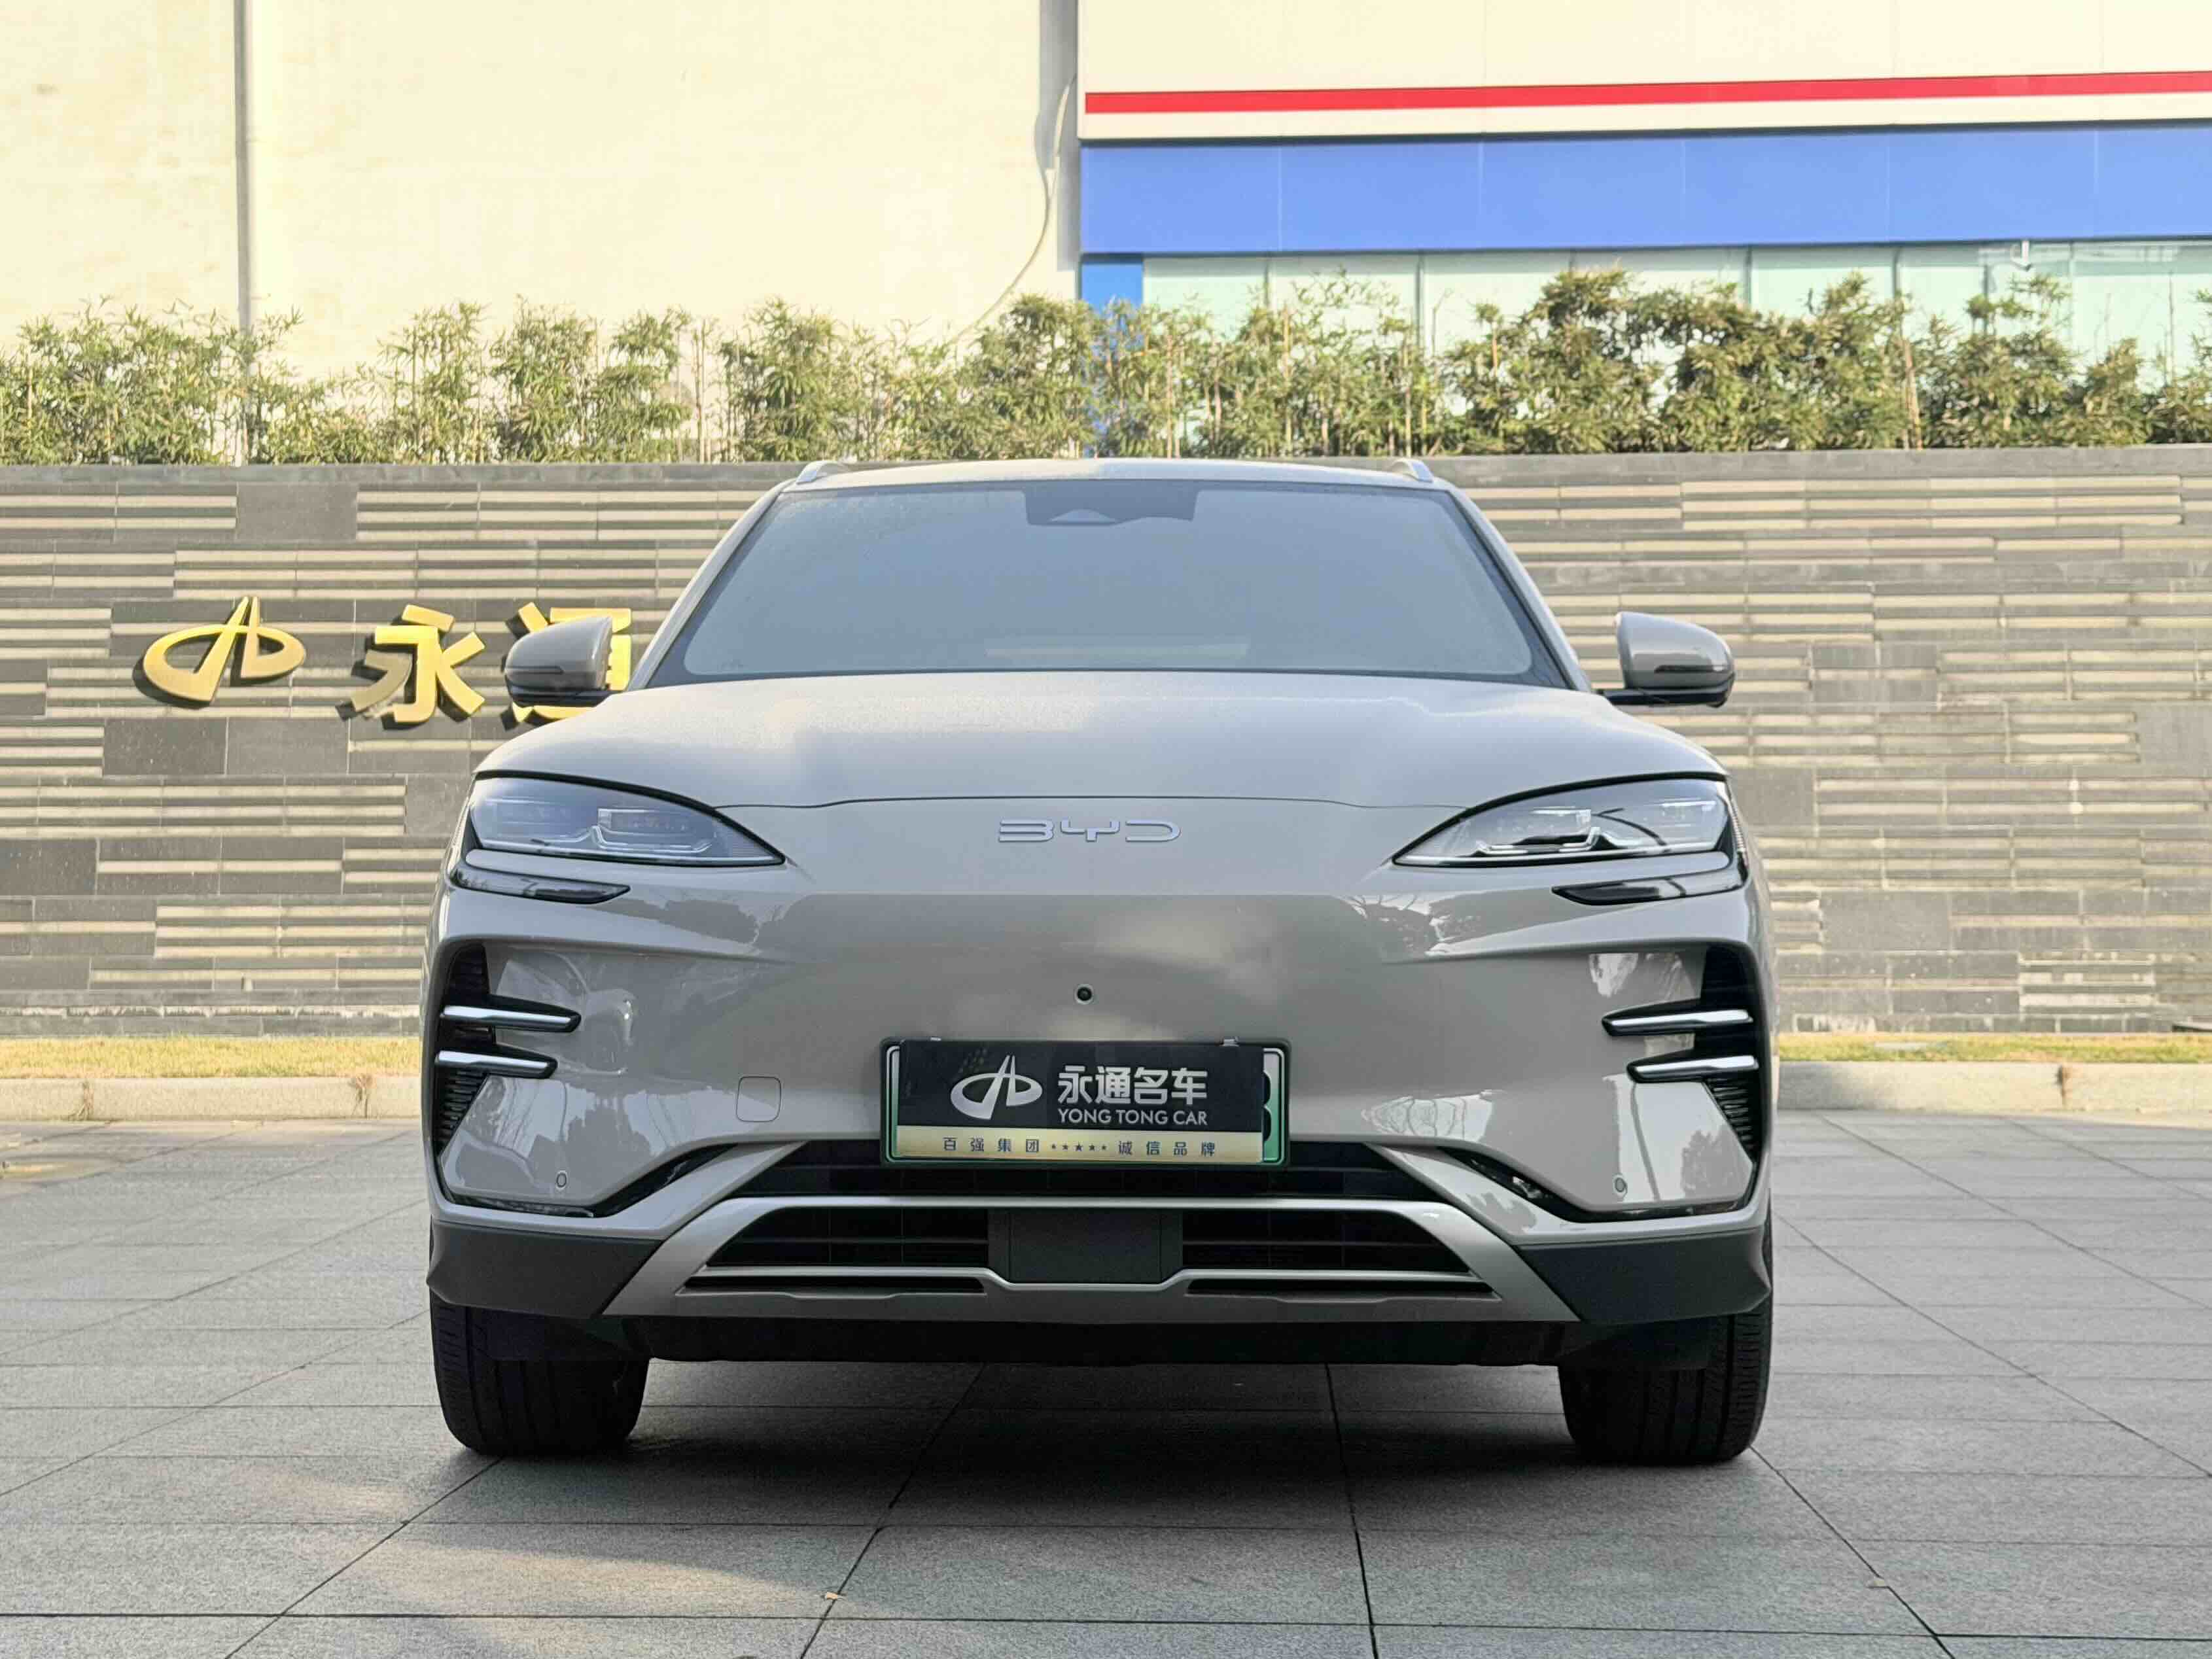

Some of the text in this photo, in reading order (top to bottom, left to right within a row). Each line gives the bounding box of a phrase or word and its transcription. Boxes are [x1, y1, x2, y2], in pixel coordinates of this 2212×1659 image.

[998, 818, 1181, 842] BYD
[1058, 1066, 1208, 1104] 永通名车
[1058, 1109, 1208, 1126] YONG TONG CAR
[943, 1137, 1215, 1157] 百强集团 诚信品牌
